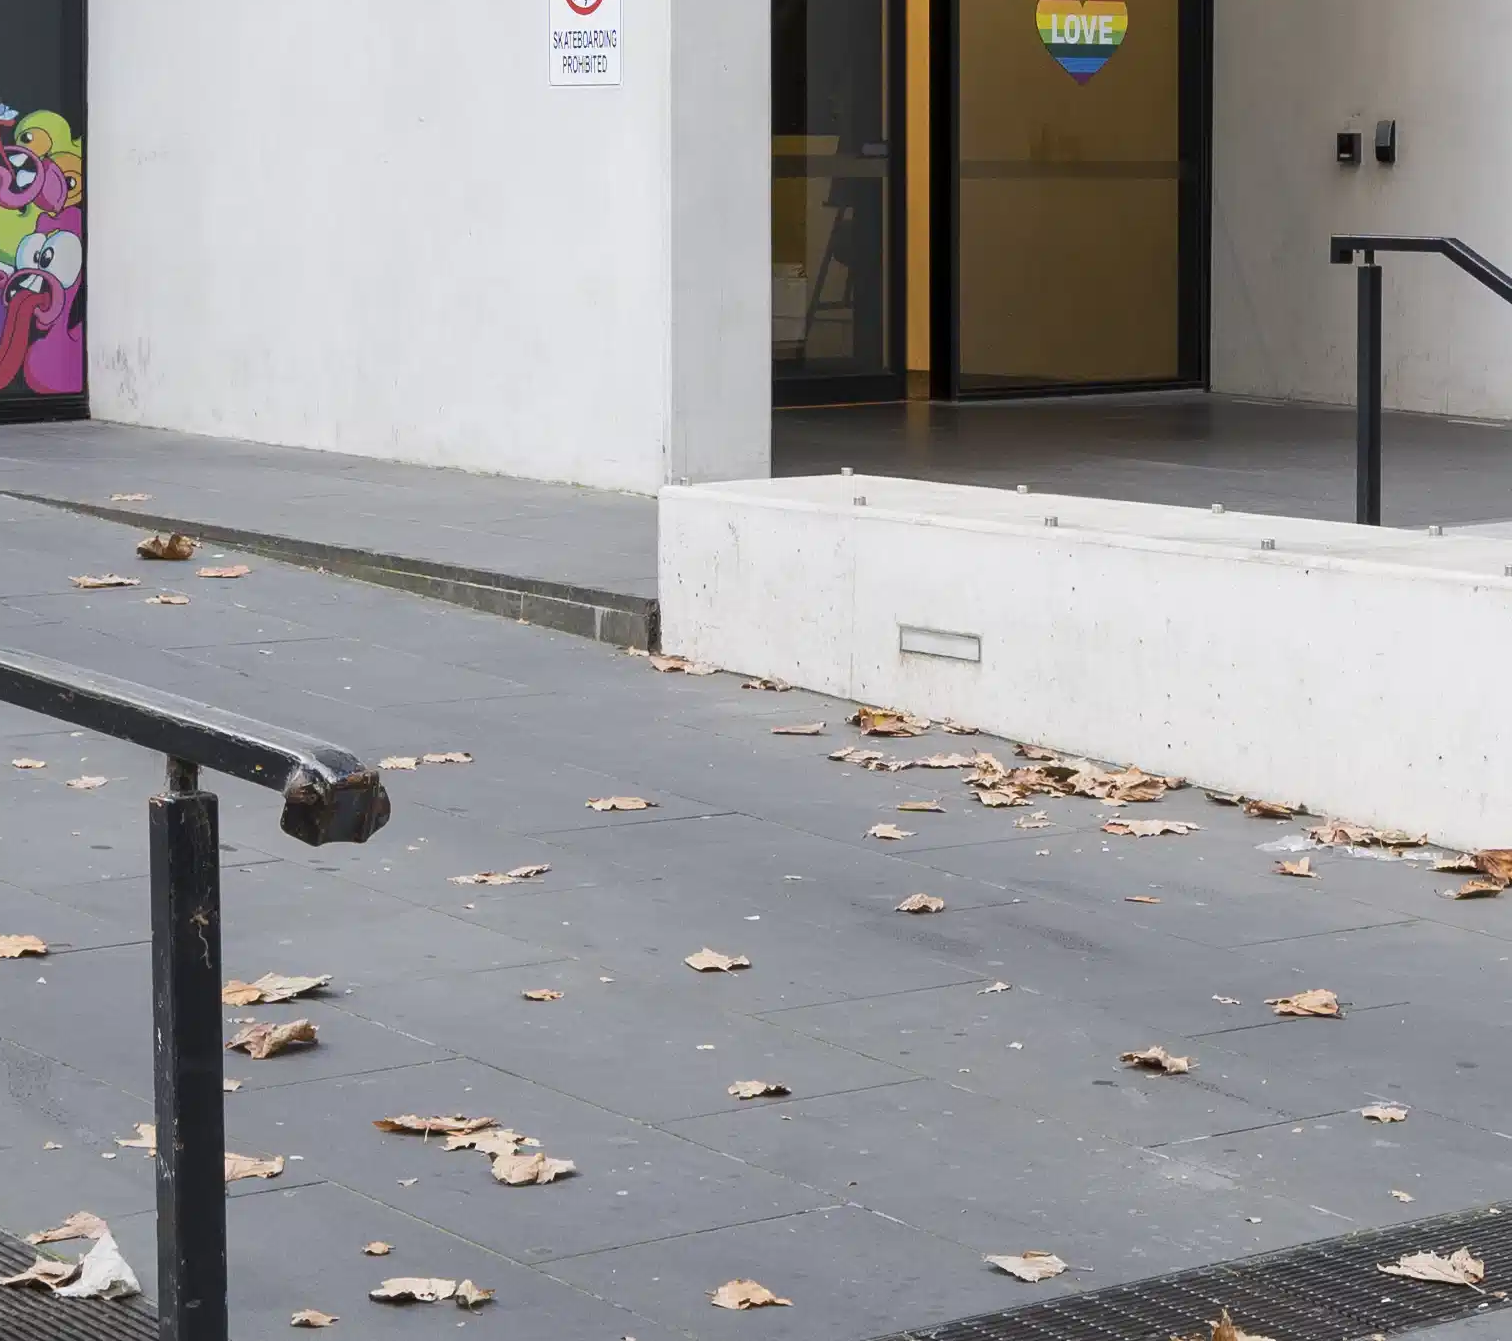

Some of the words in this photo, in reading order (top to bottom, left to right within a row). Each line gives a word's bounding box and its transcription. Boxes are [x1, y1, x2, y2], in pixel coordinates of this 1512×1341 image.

[1051, 13, 1113, 45] LOVE
[553, 30, 617, 49] SKATEBOARDING
[562, 55, 607, 73] PROHIBITED
